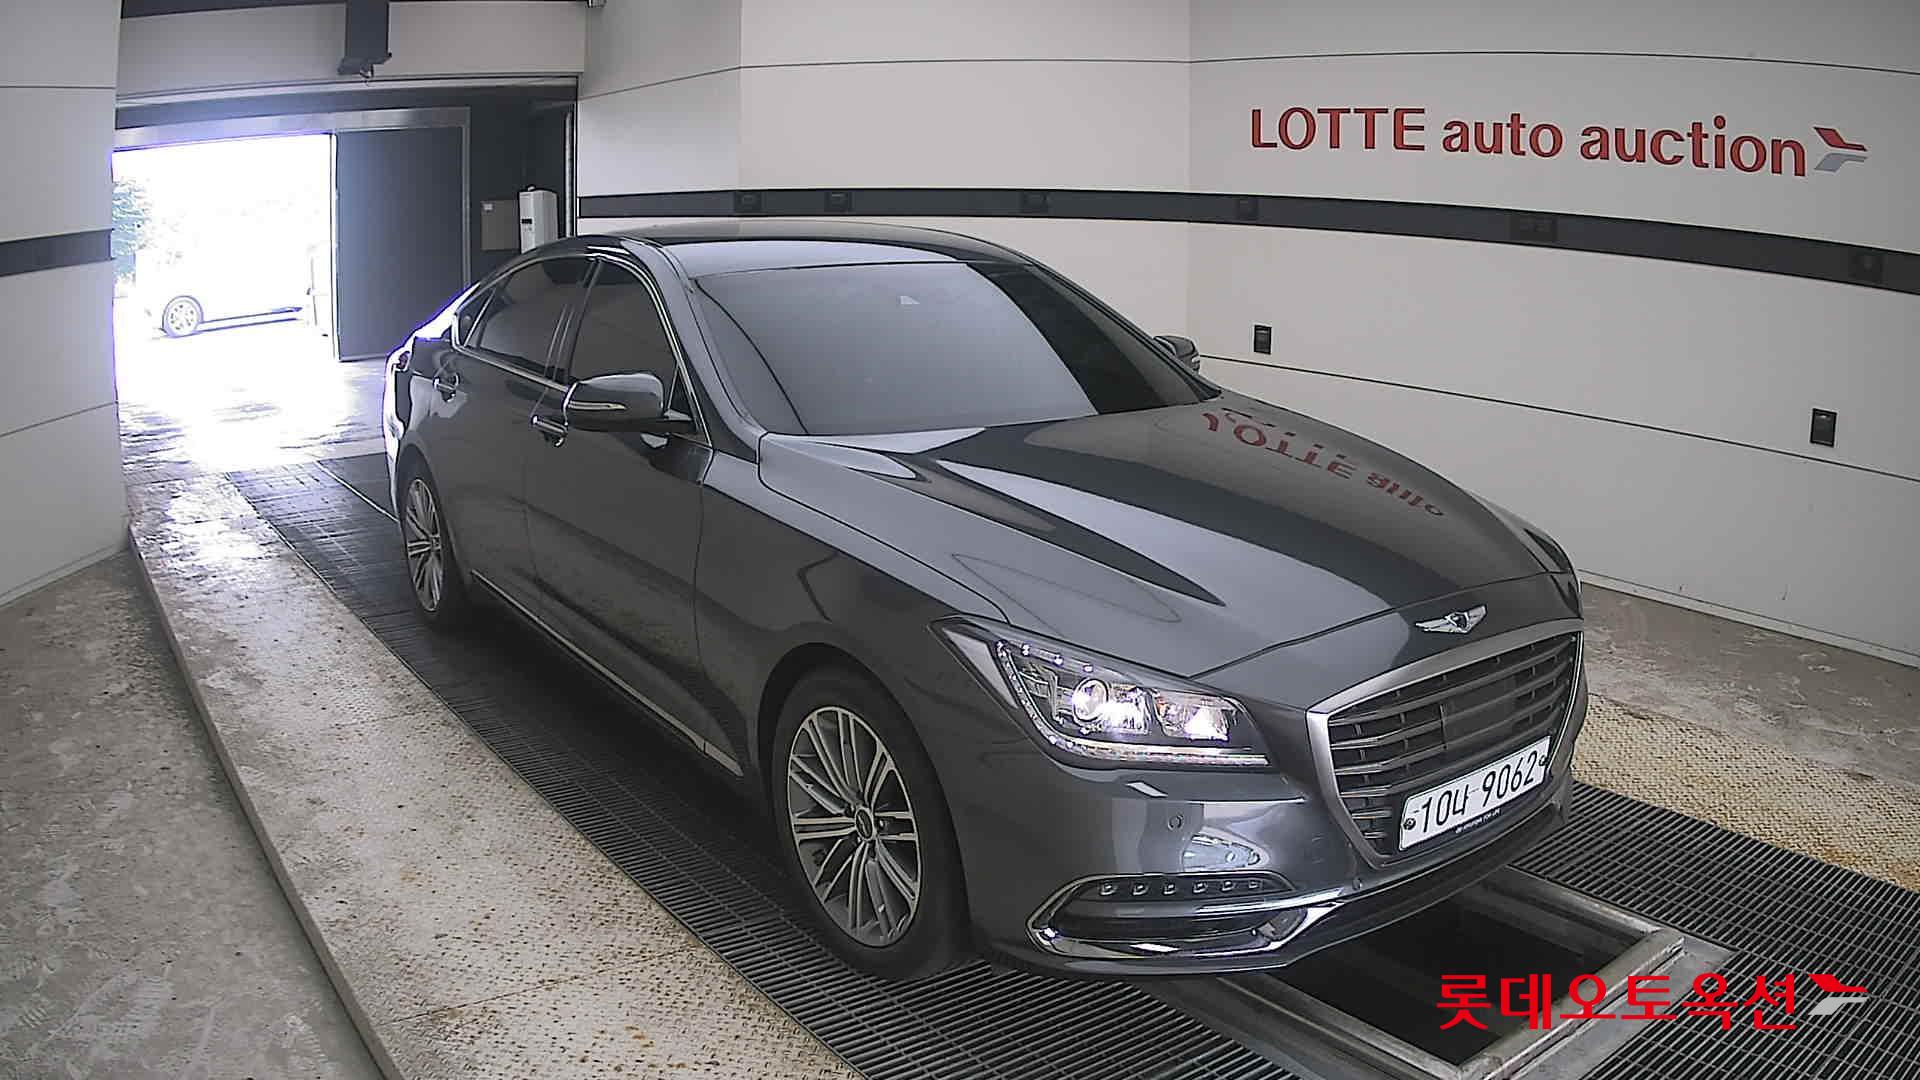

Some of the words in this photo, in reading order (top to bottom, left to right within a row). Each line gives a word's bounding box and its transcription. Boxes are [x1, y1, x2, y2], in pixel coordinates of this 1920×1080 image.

[1251, 107, 1426, 151] LOTTE
[1441, 112, 1565, 158] auto
[1580, 115, 1807, 177] auction
[1482, 750, 1539, 808] 9062
